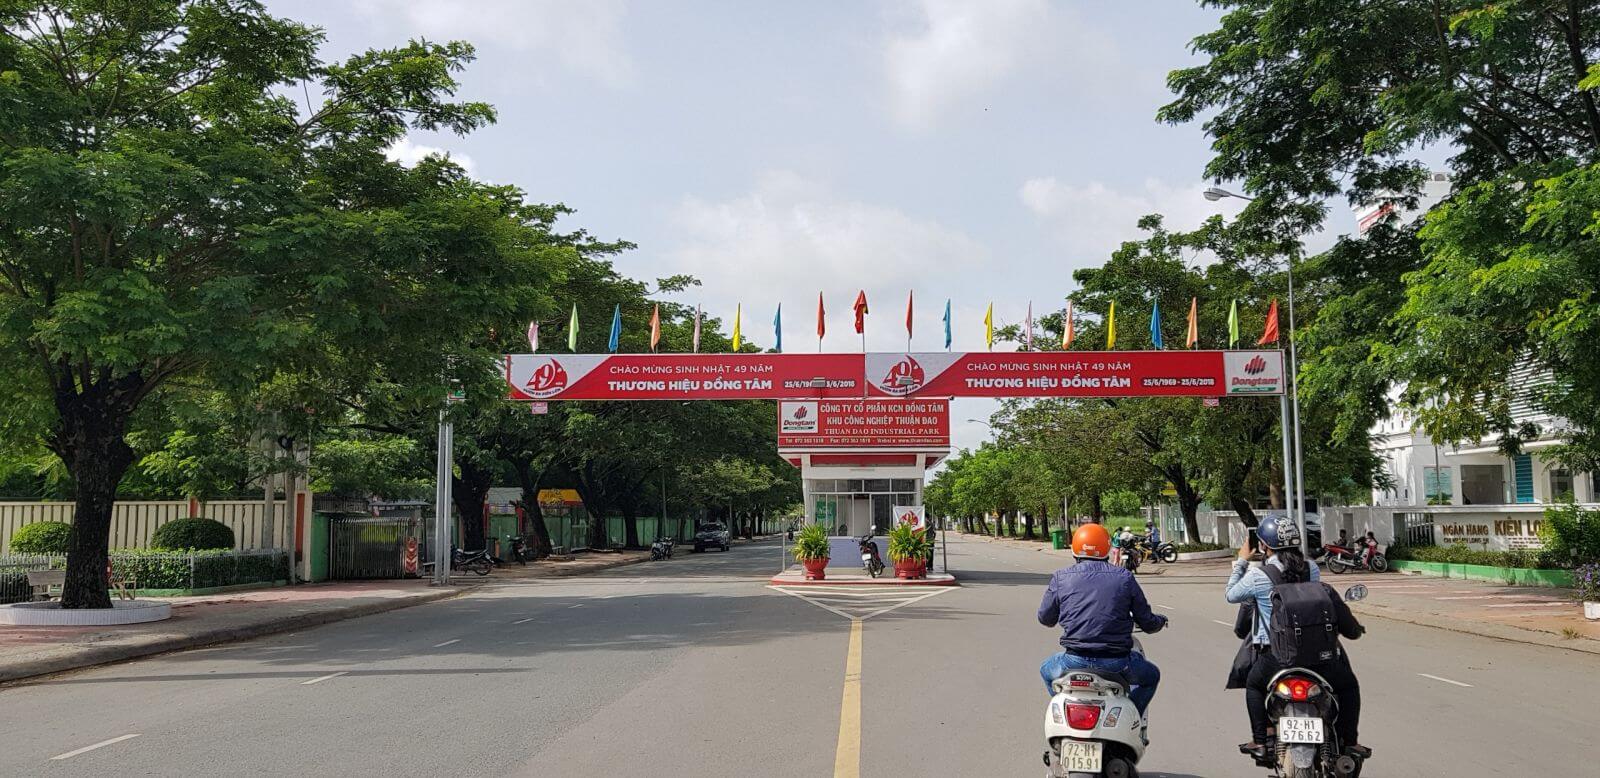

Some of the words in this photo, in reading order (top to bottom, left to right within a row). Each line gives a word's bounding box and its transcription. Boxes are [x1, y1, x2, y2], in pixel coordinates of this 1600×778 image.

[610, 364, 639, 374] CHÀO
[642, 364, 672, 374] MỪNG
[675, 365, 700, 374] SINH
[703, 363, 731, 375] NHẬT
[734, 365, 747, 373] 49
[750, 363, 773, 373] NĂM
[967, 362, 997, 371] CHÀO
[1000, 362, 1030, 372] MỪNG
[1033, 363, 1057, 372] SINH
[1060, 361, 1089, 372] NHẬT
[1091, 362, 1104, 371] 49
[1107, 361, 1131, 371] NĂM
[608, 380, 666, 391] THƯƠNG
[669, 378, 700, 393] HIỆU
[703, 376, 742, 390] ĐỒNG
[746, 378, 772, 390] TÂM
[965, 377, 1023, 388] THƯƠNG
[1026, 375, 1059, 391] HIỆU
[1061, 373, 1100, 388] ĐỒNG
[1102, 376, 1131, 388] TÂM
[1143, 378, 1177, 387] 25/6/1969
[1181, 378, 1215, 387] 25/6/2018
[1231, 377, 1278, 387] Dongtam
[820, 402, 841, 413] CÔNG
[842, 404, 852, 413] TY
[888, 404, 904, 413] KCN
[927, 402, 944, 413] TÂM
[783, 419, 816, 427] Dongtam
[826, 416, 843, 425] KHU
[844, 414, 865, 425] CÔNG
[866, 414, 894, 427] NGHIỆP
[1442, 522, 1464, 536] NGÂN
[1493, 515, 1523, 536] KIÊN
[1287, 719, 1315, 730] 92-H1
[1283, 730, 1321, 742] 576.62
